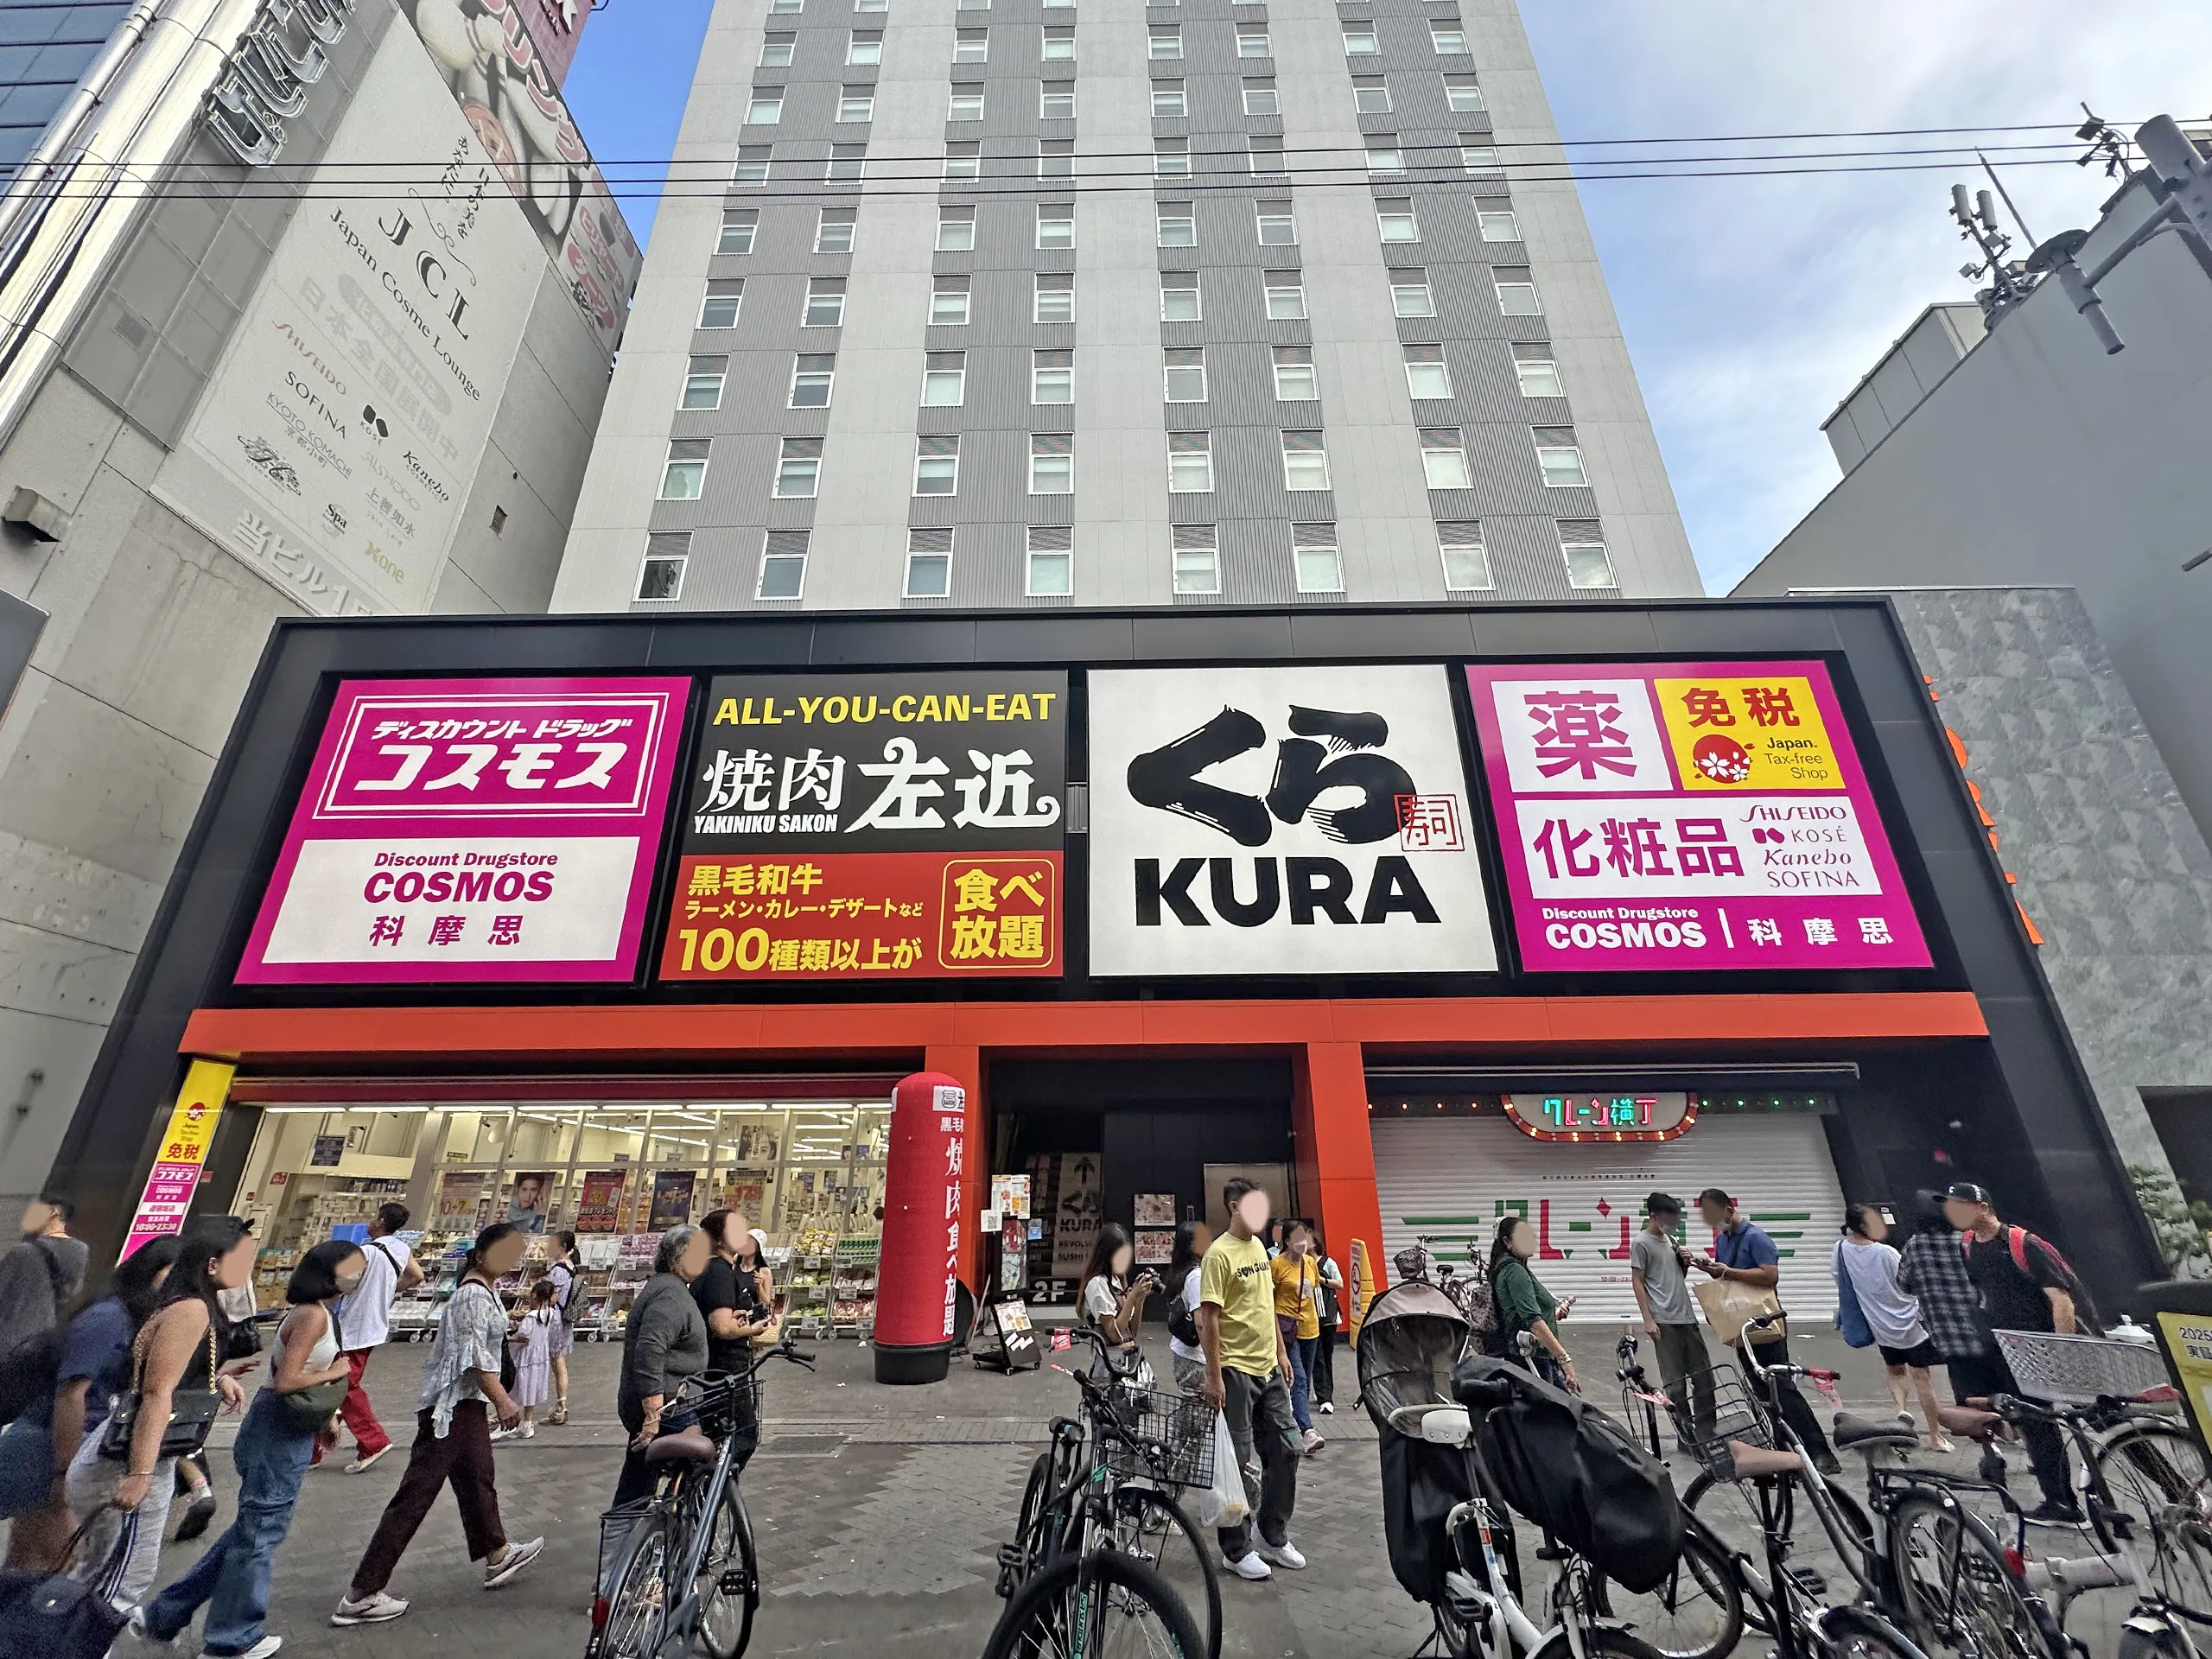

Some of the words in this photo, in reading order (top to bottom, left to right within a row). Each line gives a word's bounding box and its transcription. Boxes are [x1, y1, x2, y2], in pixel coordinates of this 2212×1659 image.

[330, 206, 378, 273] Japan
[382, 271, 431, 339] Cosme
[432, 334, 480, 401] Lounge
[270, 319, 346, 396] SHISEIDO
[284, 371, 346, 439] SOFINA
[267, 391, 306, 432] KYOTO
[307, 430, 353, 478] KOMACHI
[403, 449, 450, 502] Kanebo
[325, 503, 347, 529] Spa
[234, 511, 374, 615] 当ビル1
[713, 693, 1056, 726] ALL-YOU-CAN-EAT
[1681, 686, 1801, 728] 免税
[372, 718, 529, 740] ディスカウント
[532, 718, 633, 739] ドラッグ
[1523, 690, 1637, 780] 薬
[1766, 736, 1818, 752] Japan.
[353, 742, 628, 791] コスモス
[1127, 703, 1418, 847] くら
[1764, 753, 1823, 766] Tax-free
[1790, 766, 1829, 782] Shop
[694, 815, 776, 834] YAKINIKU
[779, 814, 838, 833] SAKON
[1739, 804, 1847, 823] SHISEIDO
[1532, 817, 1745, 880] 化粧品
[1790, 825, 1847, 843] KOSÉ
[374, 852, 460, 867] Discount
[463, 852, 558, 868] Drugstore
[1764, 849, 1853, 867] Kanebo
[364, 871, 556, 903] COSMOS
[688, 862, 823, 896] 黒毛和牛
[953, 868, 1046, 912] 食べ
[1134, 855, 1442, 928] KURA
[1766, 870, 1860, 888] SOFINA
[1542, 907, 1614, 920] Discount
[1617, 906, 1699, 922] Drugstore
[369, 915, 524, 947] 科摩思
[950, 914, 1045, 960] 放題
[1546, 922, 1707, 950] COSMOS
[1747, 917, 1894, 947] 科摩思
[678, 927, 923, 972] 100種類以上が
[1542, 1097, 1659, 1126] クレーン横丁
[166, 1142, 200, 1160] 免税
[155, 1171, 194, 1180] コスモス
[1033, 1281, 1067, 1302] 2F
